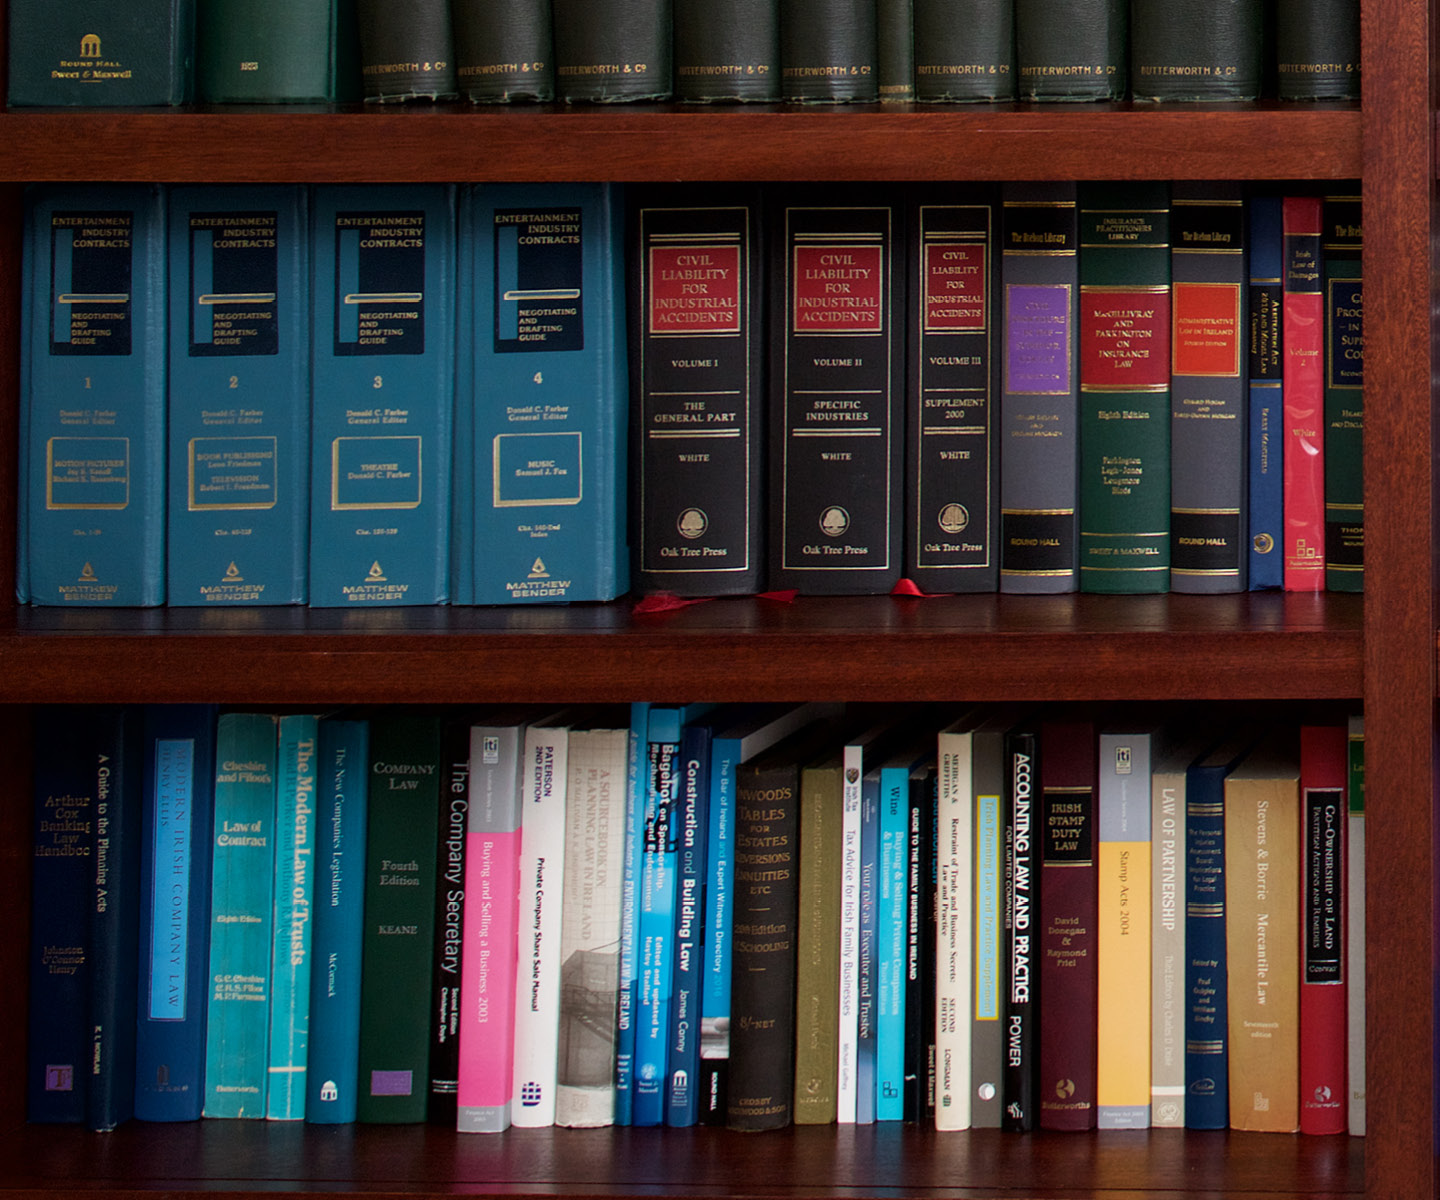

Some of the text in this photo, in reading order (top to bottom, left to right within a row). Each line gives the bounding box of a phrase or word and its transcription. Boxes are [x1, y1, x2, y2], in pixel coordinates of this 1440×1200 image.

[495, 214, 579, 223] ENTERTAINMENT
[528, 225, 580, 233] INDUSTRY
[518, 236, 580, 245] CONTRACTS
[676, 255, 714, 266] CIVIL
[662, 269, 729, 280] LIABILITY
[682, 283, 708, 294] FOR
[655, 297, 737, 308] INDUSTRIAL
[518, 308, 577, 316] NEGOTIATING
[658, 311, 733, 322] ACCIDENTS
[519, 325, 563, 333] DRAFTING
[814, 358, 862, 366] VOLUME II
[533, 372, 543, 384] 4
[684, 402, 706, 411] THE
[814, 401, 861, 410] SPECIFIC
[654, 412, 736, 423] GENERAL PART
[806, 411, 869, 421] INDUSTRIES
[678, 454, 710, 462] WHITE
[660, 547, 727, 557] Oak Tree Press
[506, 581, 571, 590] MATTHEW
[512, 589, 566, 598] BENDER
[1052, 804, 1082, 813] IRISH
[1049, 817, 1085, 826] STAMP
[223, 821, 261, 832] Law of
[1052, 829, 1081, 838] DUTY
[217, 835, 266, 847] Contract
[1055, 842, 1078, 850] LAW
[1161, 788, 1176, 931] LAW OF PARTNERSHIP
[441, 762, 469, 974] The Company Secretary
[679, 760, 699, 972] Construction and Building Law
[1014, 753, 1031, 1004] ACCOUNTING LAW AND PRACTICE
[378, 925, 418, 934] KEANE
[1009, 1016, 1022, 1067] POWER
